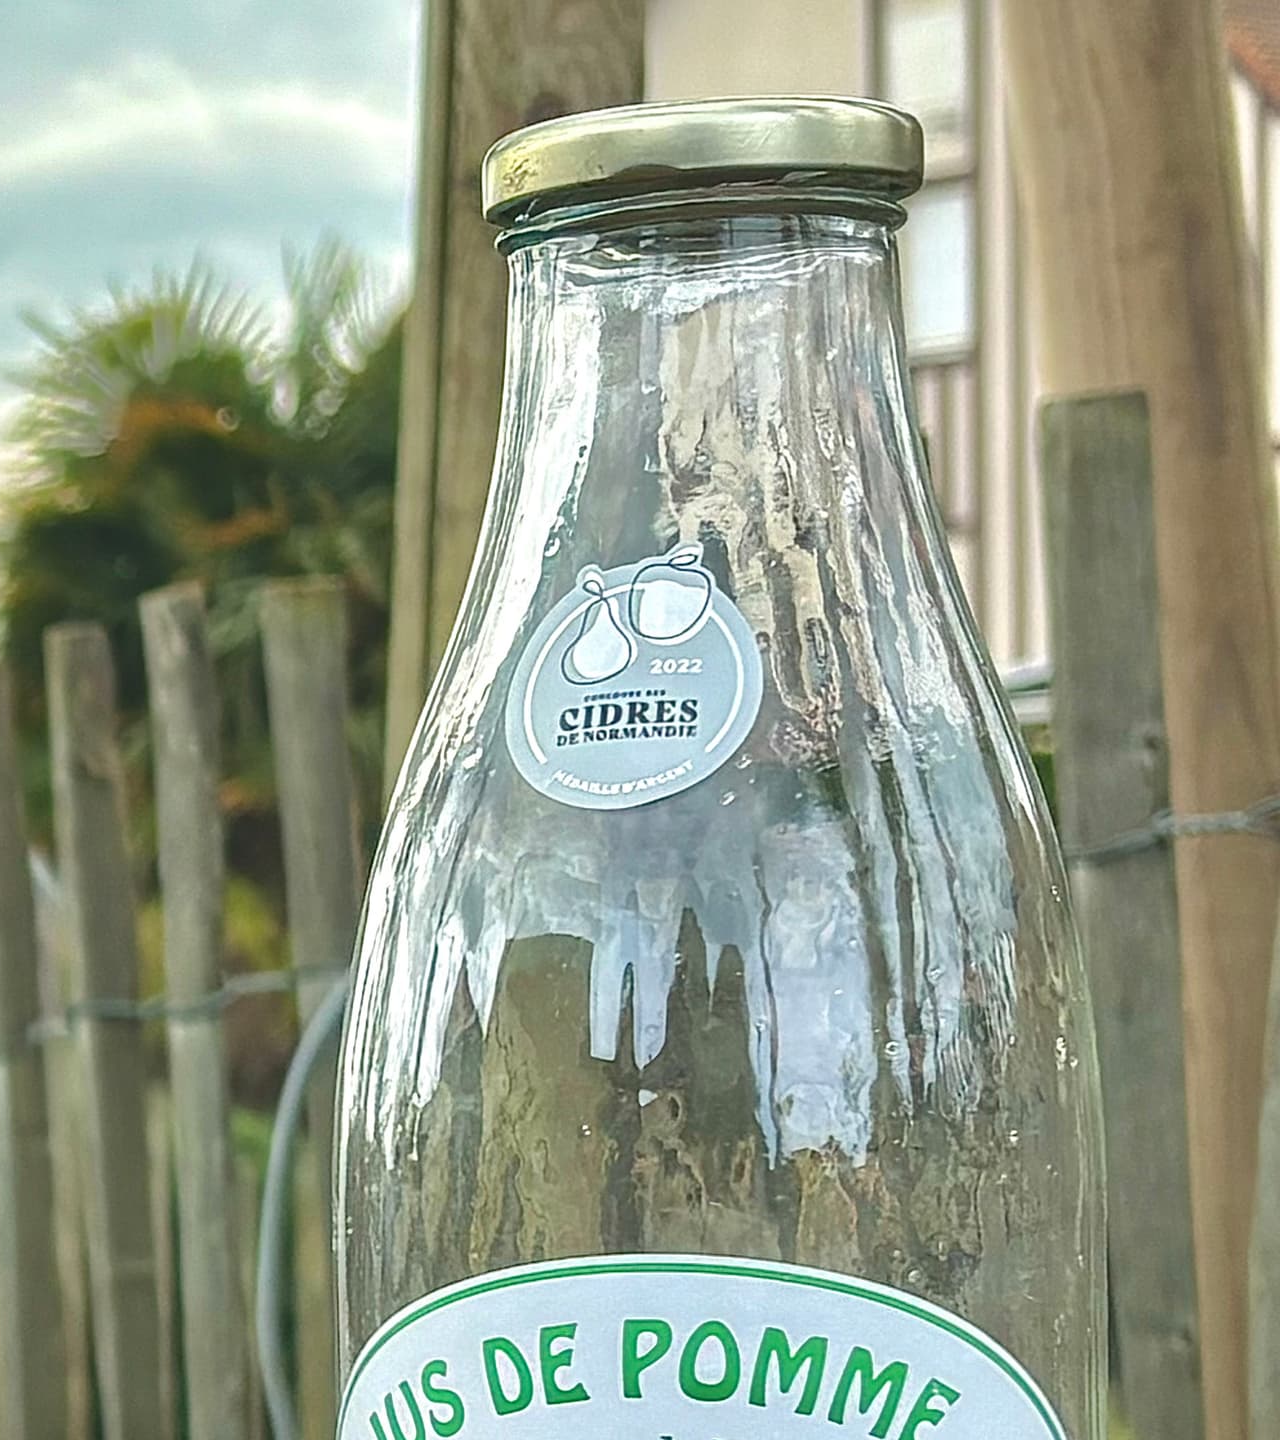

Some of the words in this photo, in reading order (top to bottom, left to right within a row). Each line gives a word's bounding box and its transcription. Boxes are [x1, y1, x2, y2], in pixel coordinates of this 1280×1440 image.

[650, 658, 703, 675] 2022
[559, 699, 698, 732] CIDRES
[557, 733, 580, 747] DE
[584, 725, 698, 743] NORMANDIE
[482, 1322, 591, 1416] DE
